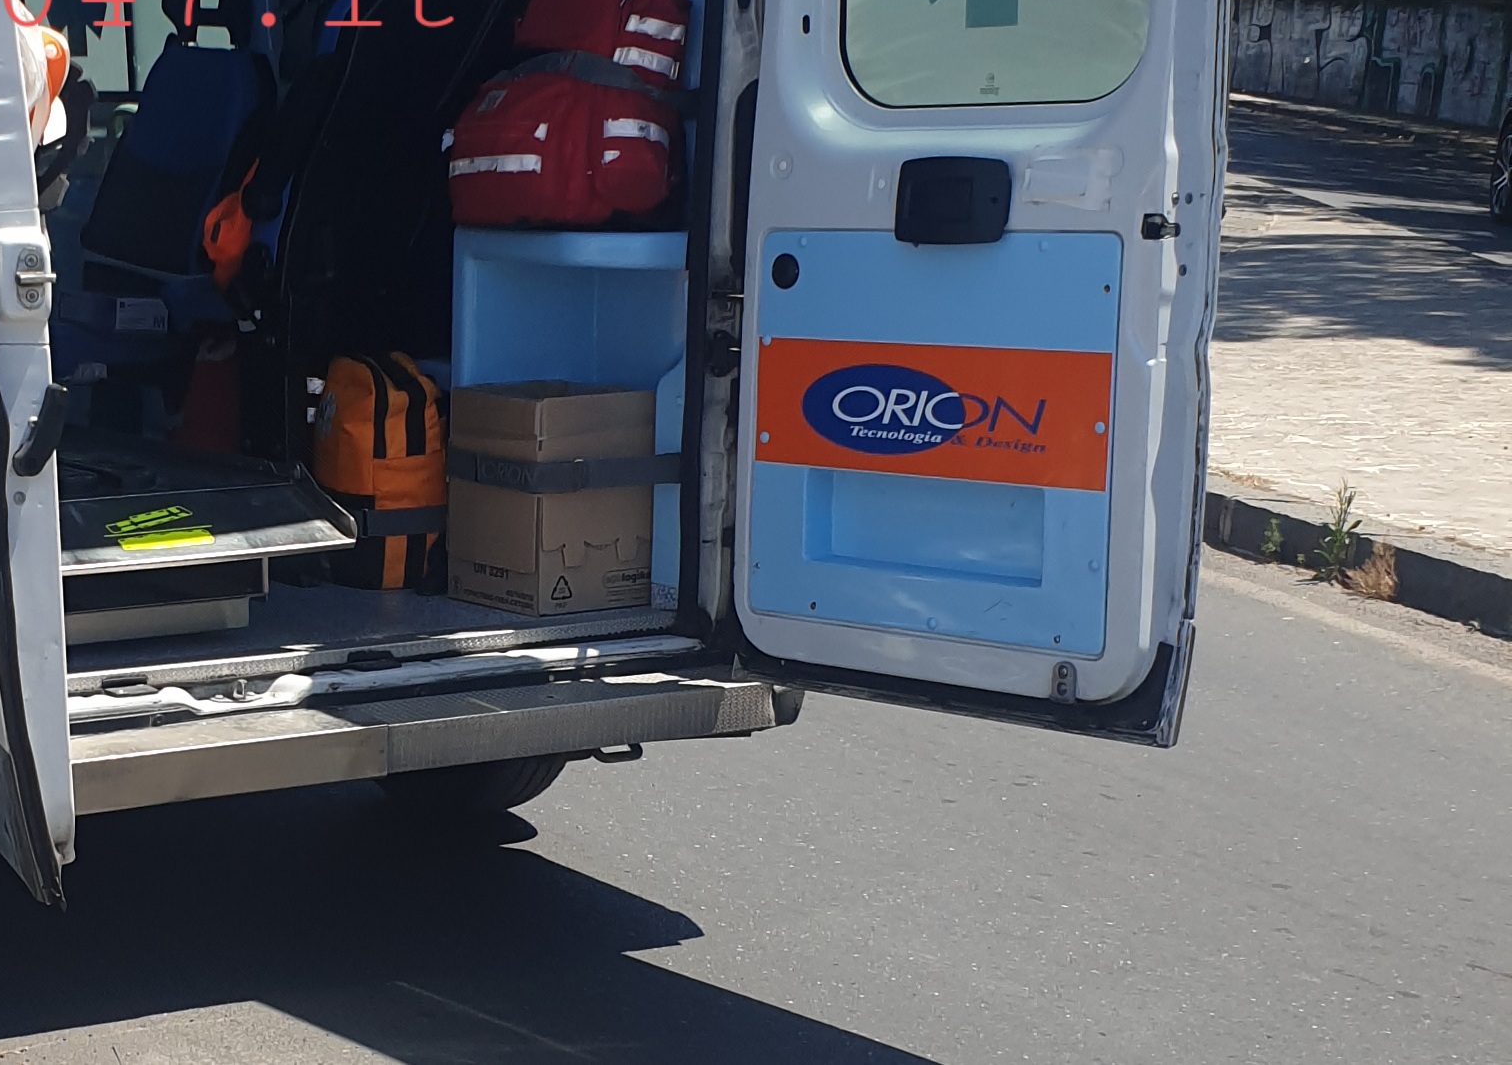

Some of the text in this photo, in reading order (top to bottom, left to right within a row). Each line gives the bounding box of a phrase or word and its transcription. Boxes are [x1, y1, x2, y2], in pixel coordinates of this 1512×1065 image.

[832, 386, 1047, 435] ORION
[850, 426, 942, 444] Tecnologia
[976, 435, 1046, 454] Design
